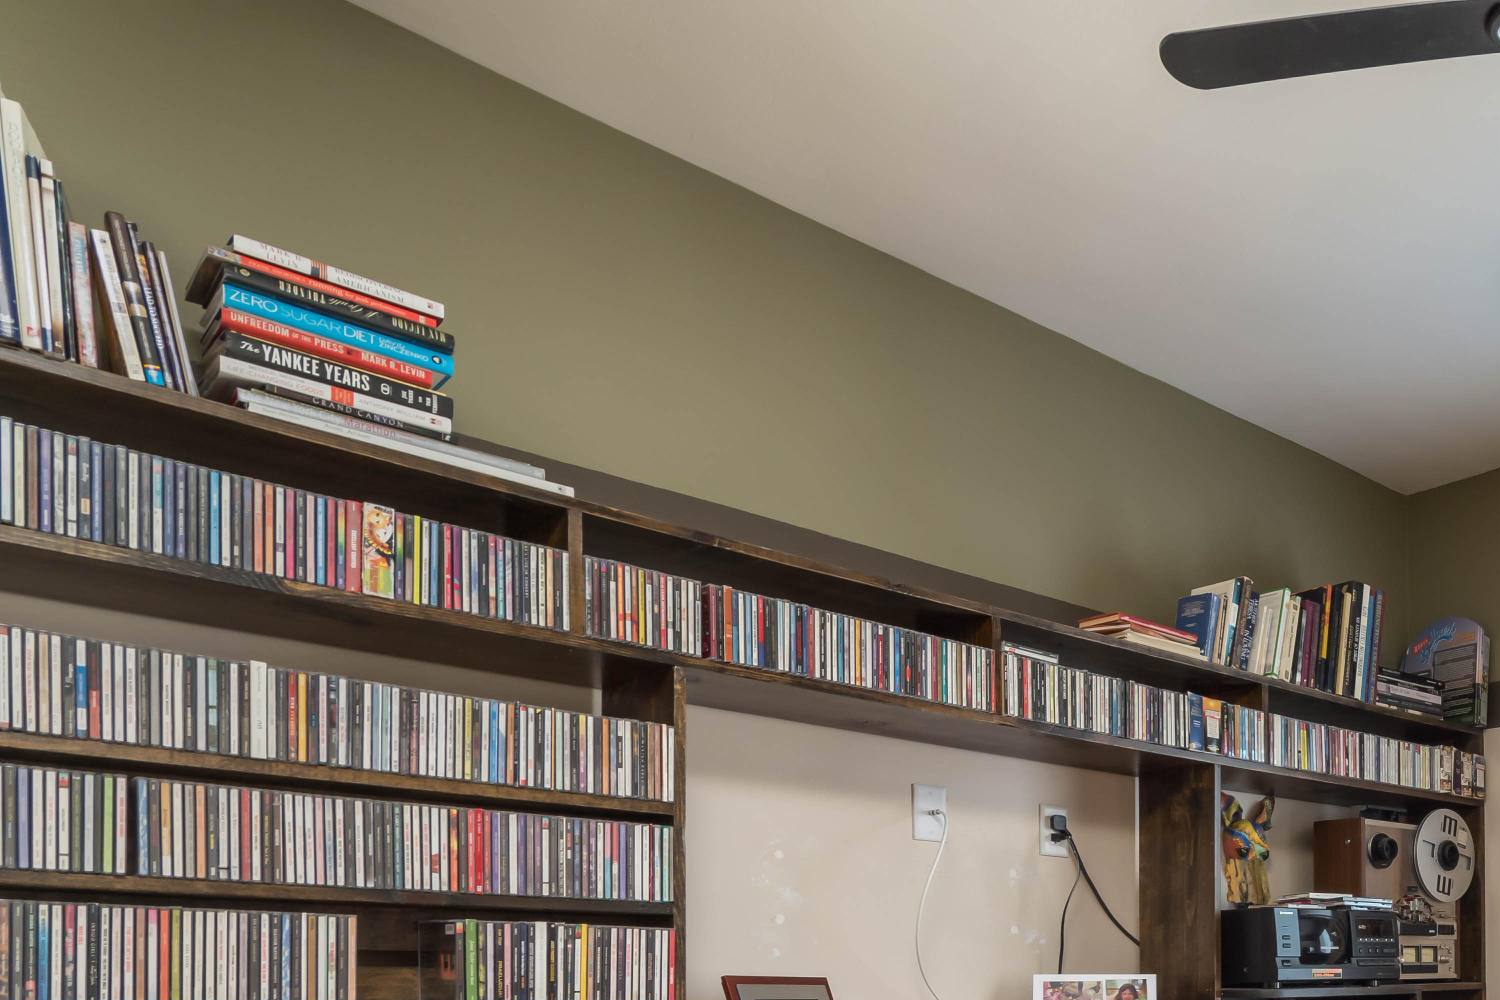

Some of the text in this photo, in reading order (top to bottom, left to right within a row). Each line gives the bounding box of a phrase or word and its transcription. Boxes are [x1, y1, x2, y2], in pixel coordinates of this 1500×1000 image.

[230, 288, 376, 345] ZERO SUGAR DIET
[230, 311, 290, 337] UNFREEDOM
[313, 337, 345, 355] PRESS
[239, 340, 371, 392] The YANKEE YEARS
[361, 351, 388, 369] MARK
[400, 363, 426, 379] LEVIN
[312, 397, 404, 428] GRAND CANYON
